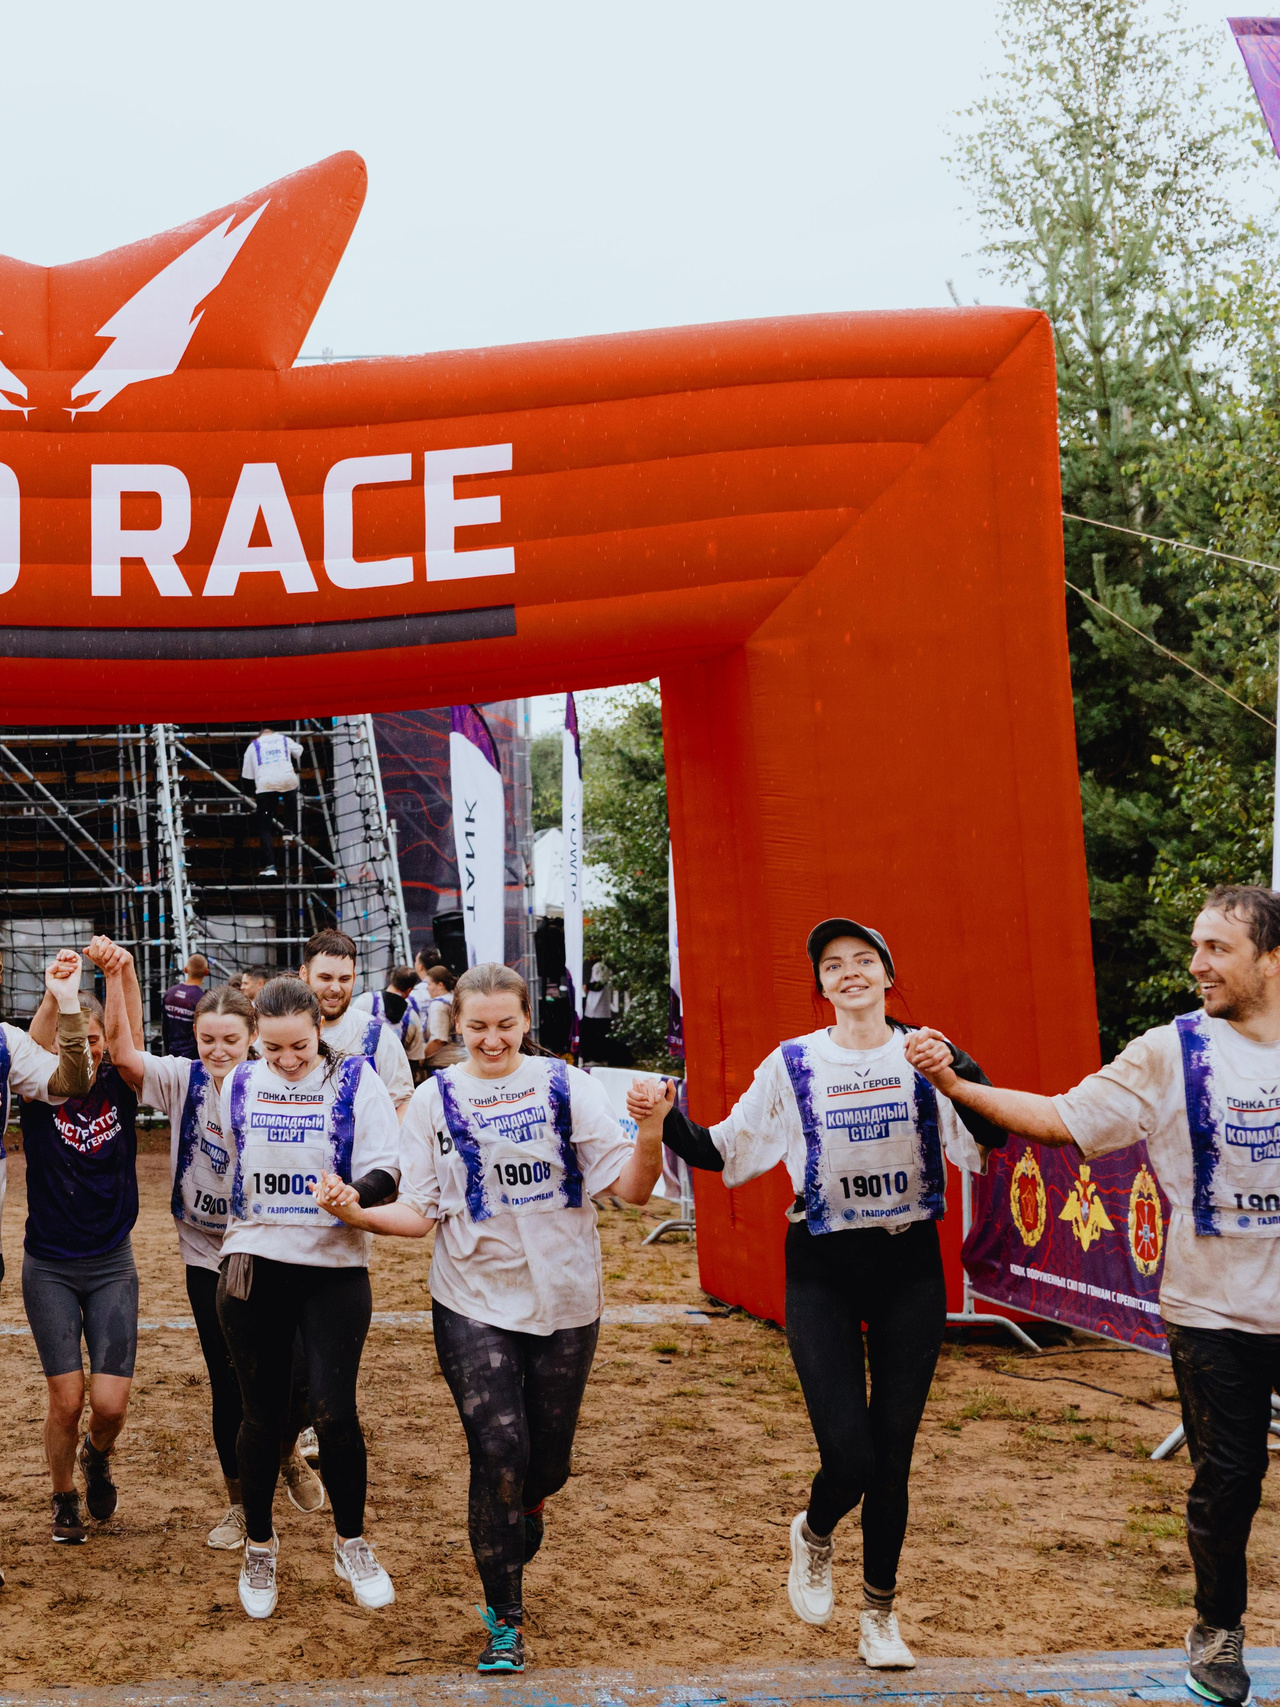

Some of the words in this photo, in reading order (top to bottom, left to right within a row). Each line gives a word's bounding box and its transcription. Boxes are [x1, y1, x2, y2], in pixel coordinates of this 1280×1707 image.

[91, 443, 516, 597] RACE
[827, 1082, 860, 1094] ГОНКА
[863, 1076, 901, 1090] ГЕРОЕВ
[257, 1091, 286, 1101] ГОНКА
[289, 1094, 324, 1102] ГЕРОЕВ
[469, 1095, 498, 1105] ГОНКА
[500, 1087, 535, 1101] ГЕРОЕВ
[1226, 1097, 1265, 1109] ГОНКА
[252, 1113, 324, 1129] КОМАНДНЫЙ
[474, 1105, 545, 1130] КАНДНЫЙ
[827, 1102, 907, 1127] КОМАНДНЫЙ
[86, 1122, 122, 1149] ГЕРОЕВ
[206, 1120, 224, 1135] ГОН
[269, 1128, 303, 1141] СТАРТ
[850, 1122, 888, 1141] СТАРТ
[201, 1140, 229, 1163] КОМАН
[494, 1161, 551, 1186] 19008
[840, 1171, 908, 1199] 19010
[194, 1190, 229, 1215] 1900
[267, 1206, 319, 1215] ГАЗПРОМБАНК
[861, 1204, 911, 1218] ГАЗПРОМБАНК
[200, 1219, 228, 1230] ГАЗПРОМ
[1258, 1216, 1280, 1226] ГАЗП
[1078, 1282, 1087, 1294] ПО
[1111, 1291, 1117, 1303] С
[1116, 1293, 1161, 1315] ПРЕПЯТСТВИЯ
